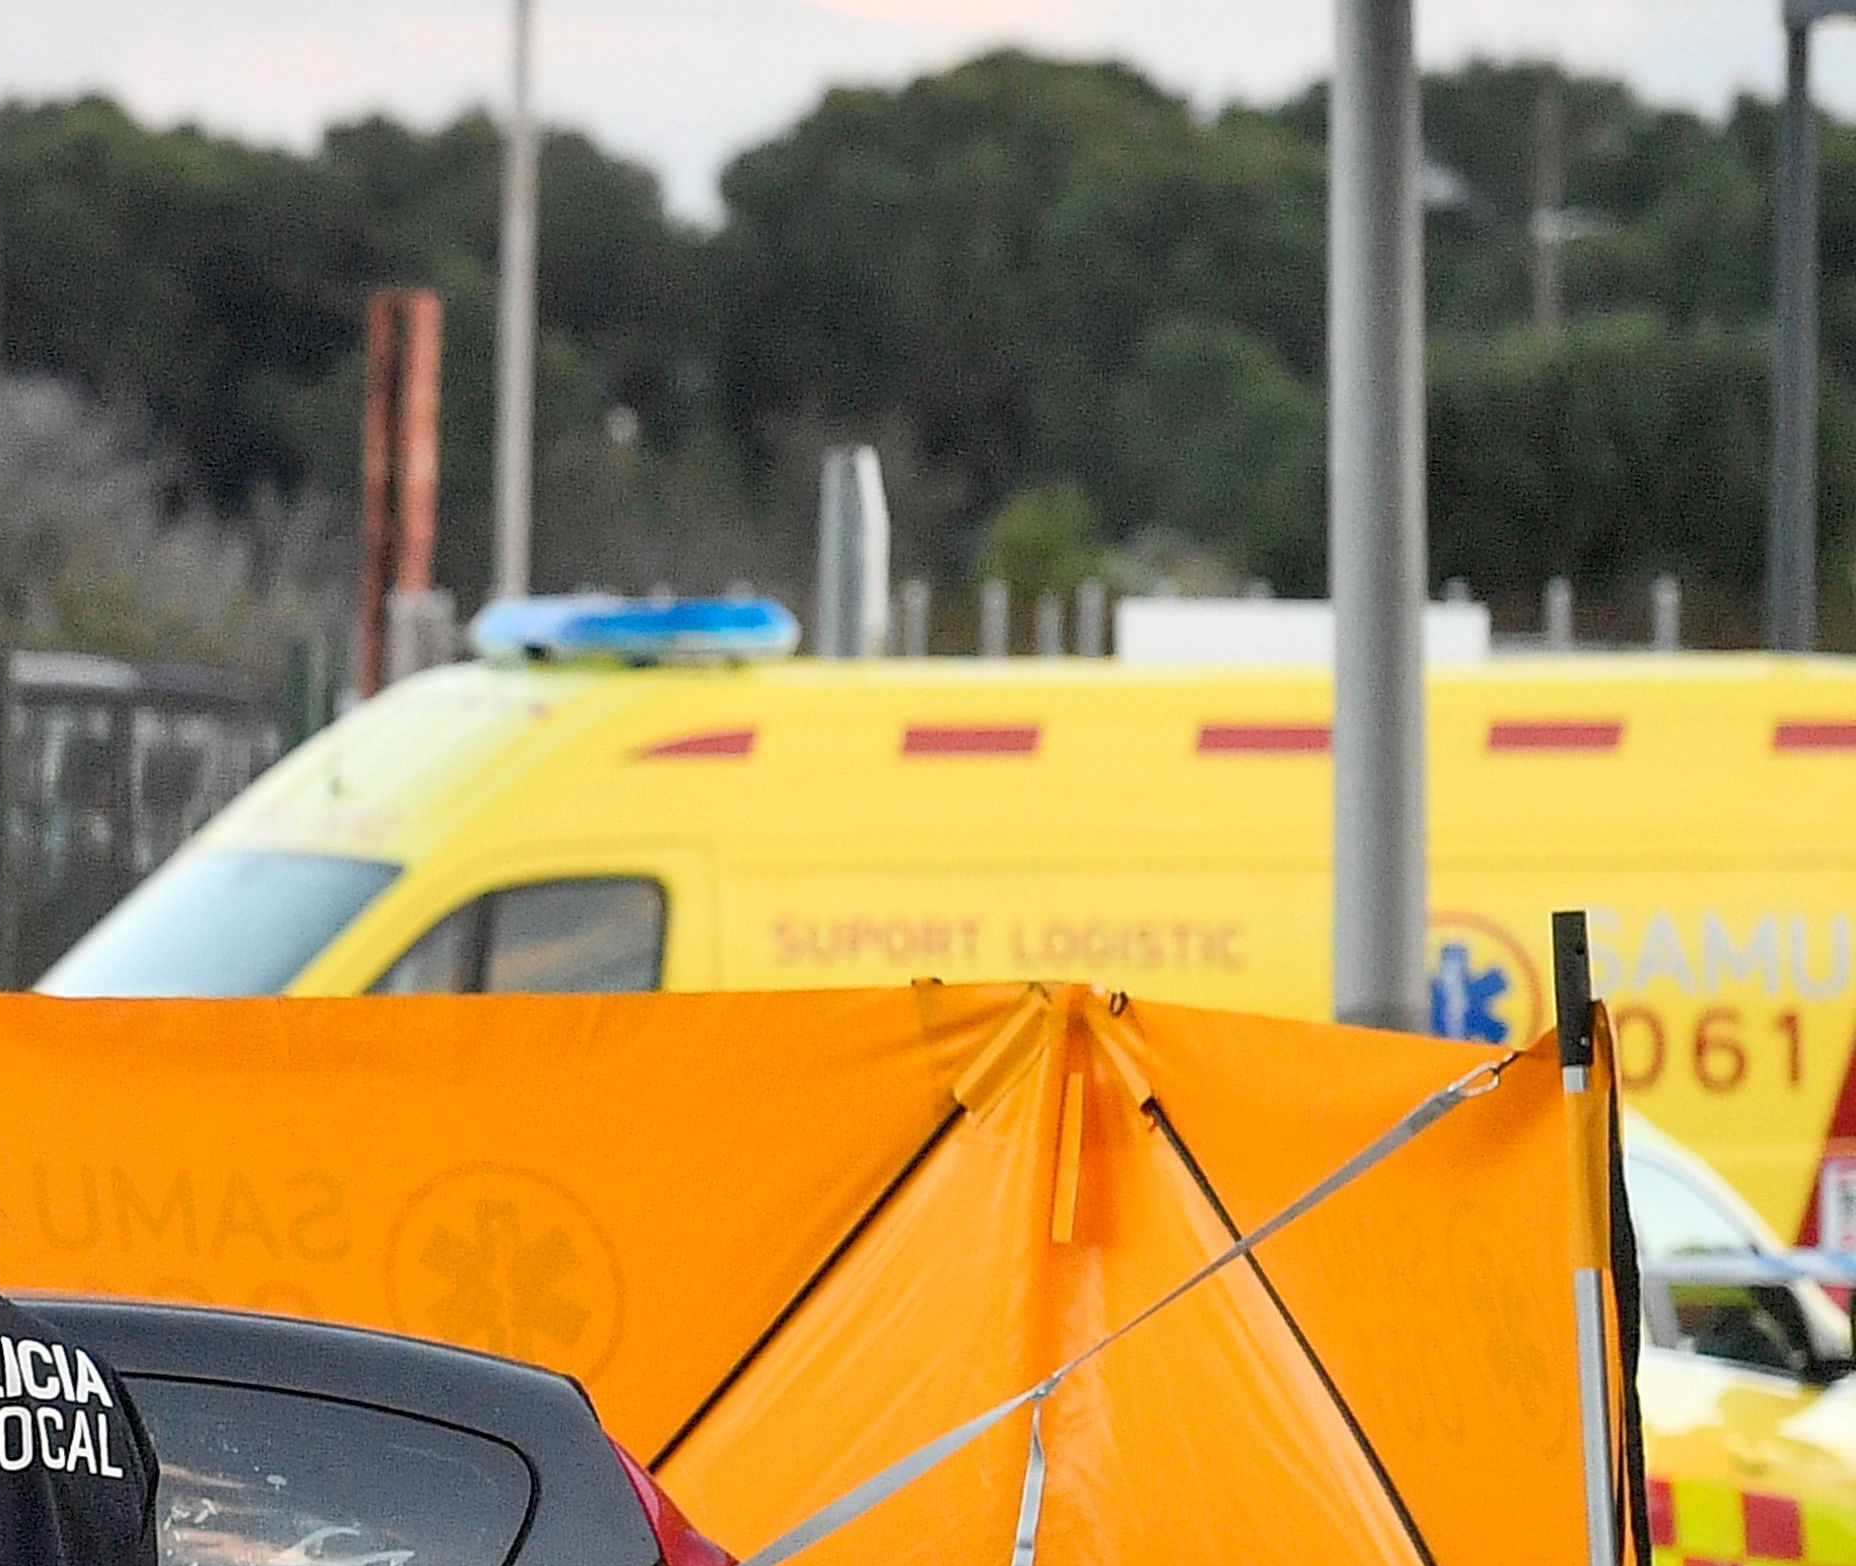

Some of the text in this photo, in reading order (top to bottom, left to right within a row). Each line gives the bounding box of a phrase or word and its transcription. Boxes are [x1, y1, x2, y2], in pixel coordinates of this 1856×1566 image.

[773, 915, 1245, 973] SUPORT LOGISTIC
[1589, 905, 1852, 1003] SAMU
[1616, 1004, 1804, 1093] 061
